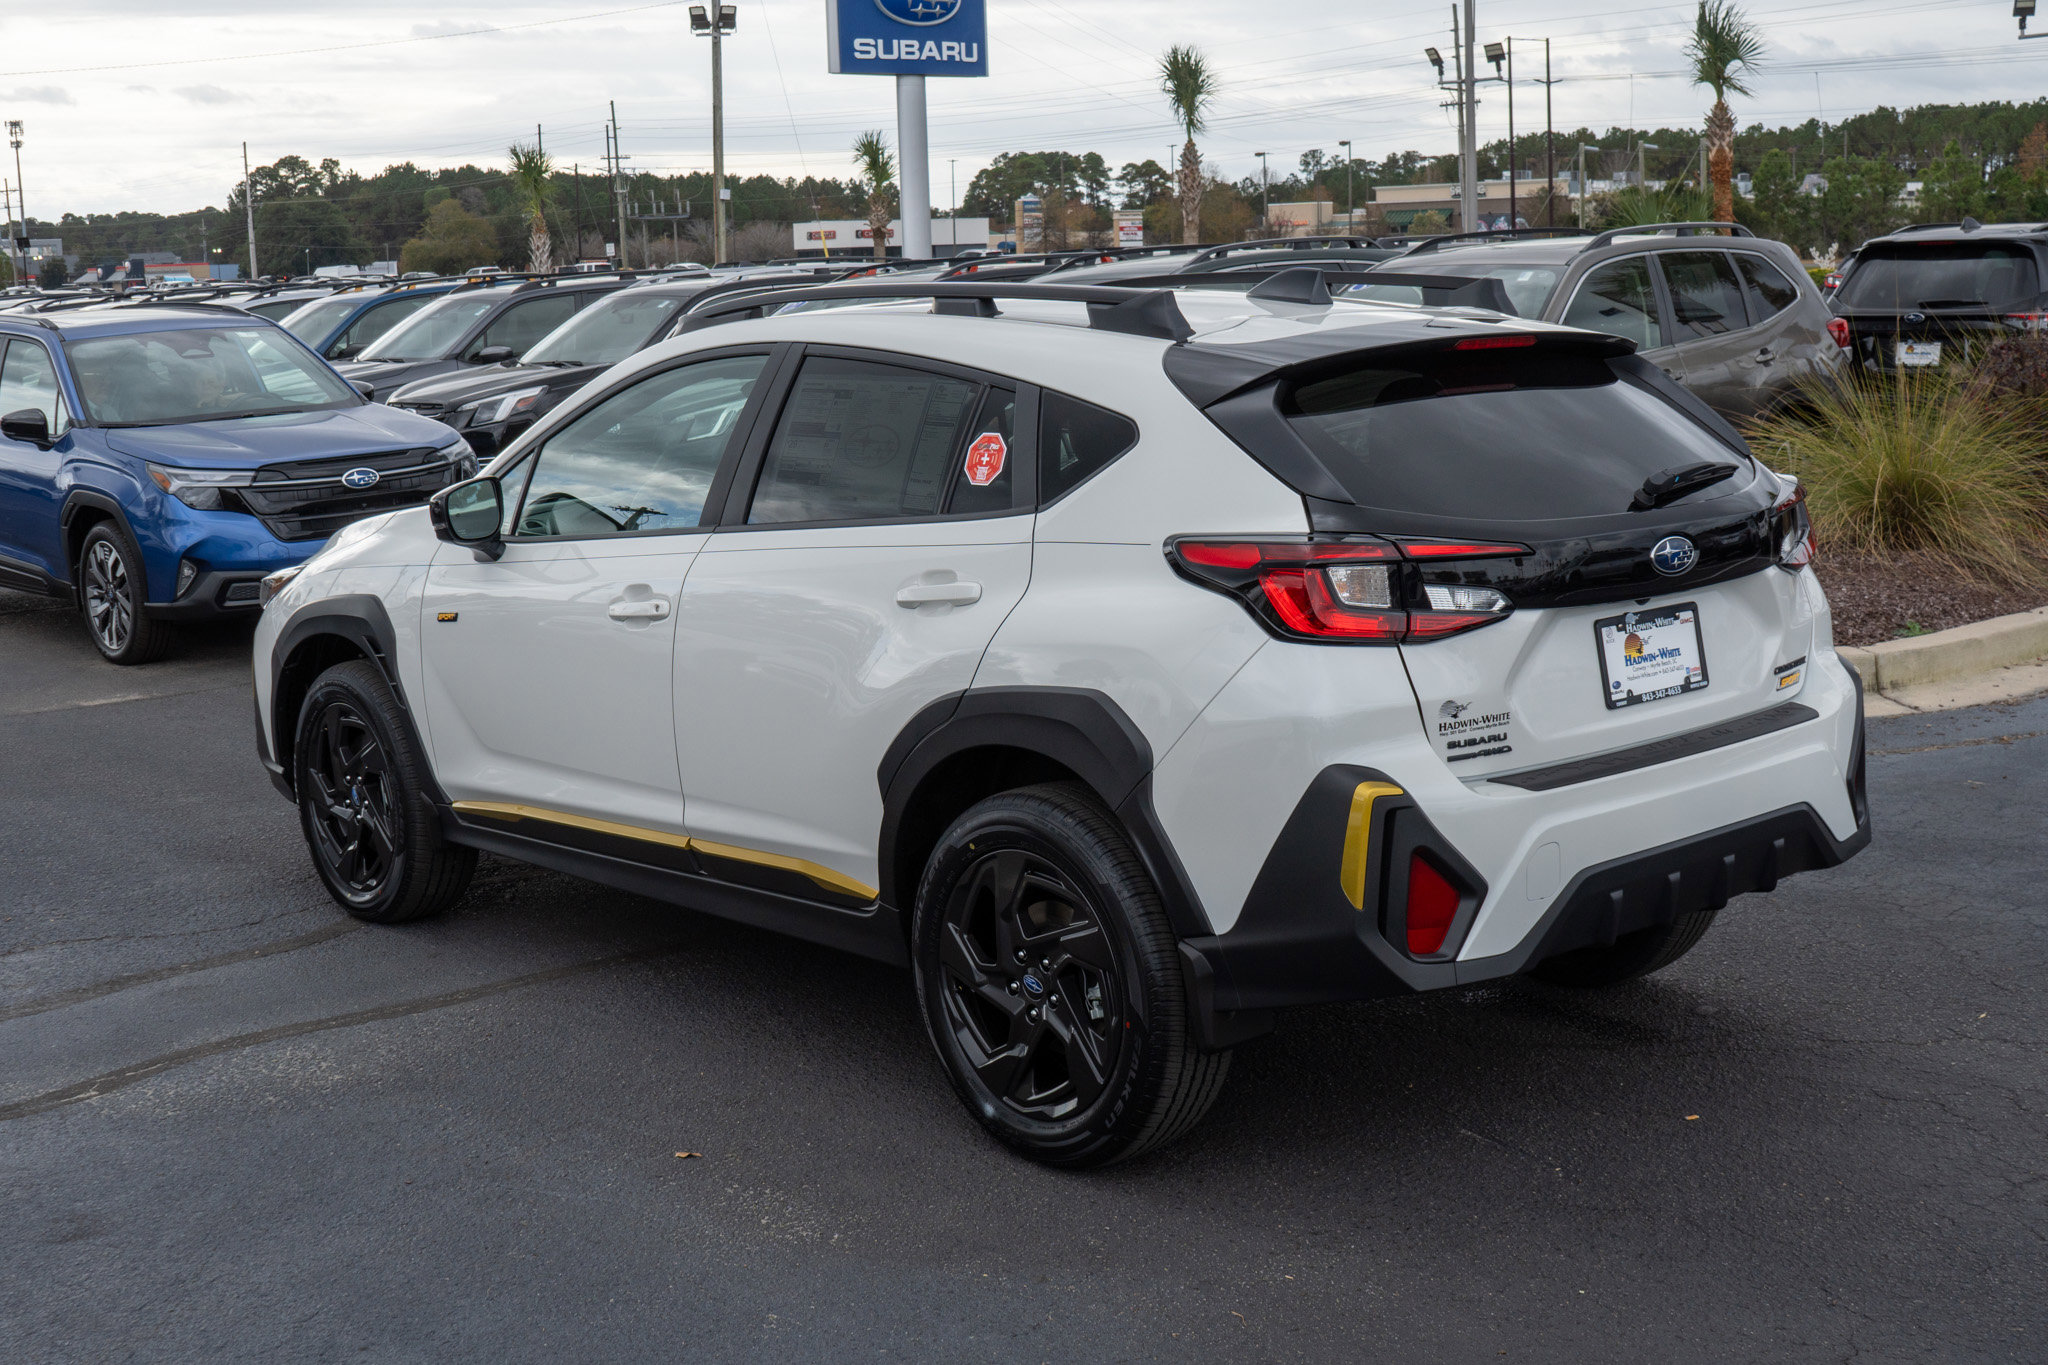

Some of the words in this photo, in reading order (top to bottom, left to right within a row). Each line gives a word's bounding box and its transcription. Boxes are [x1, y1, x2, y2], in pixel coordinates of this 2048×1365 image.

[853, 38, 978, 63] SUBARU
[1625, 617, 1675, 633] HADWIN-WHITE
[1680, 617, 1693, 625] GMC
[1624, 647, 1681, 666] HADWIN-WHITE
[1780, 671, 1800, 688] SPORT
[1641, 685, 1682, 701] 843-347-4633
[1438, 711, 1511, 732] HADWIN-WHITE
[1447, 732, 1508, 750] SUBARU
[1477, 745, 1513, 757] AWD
